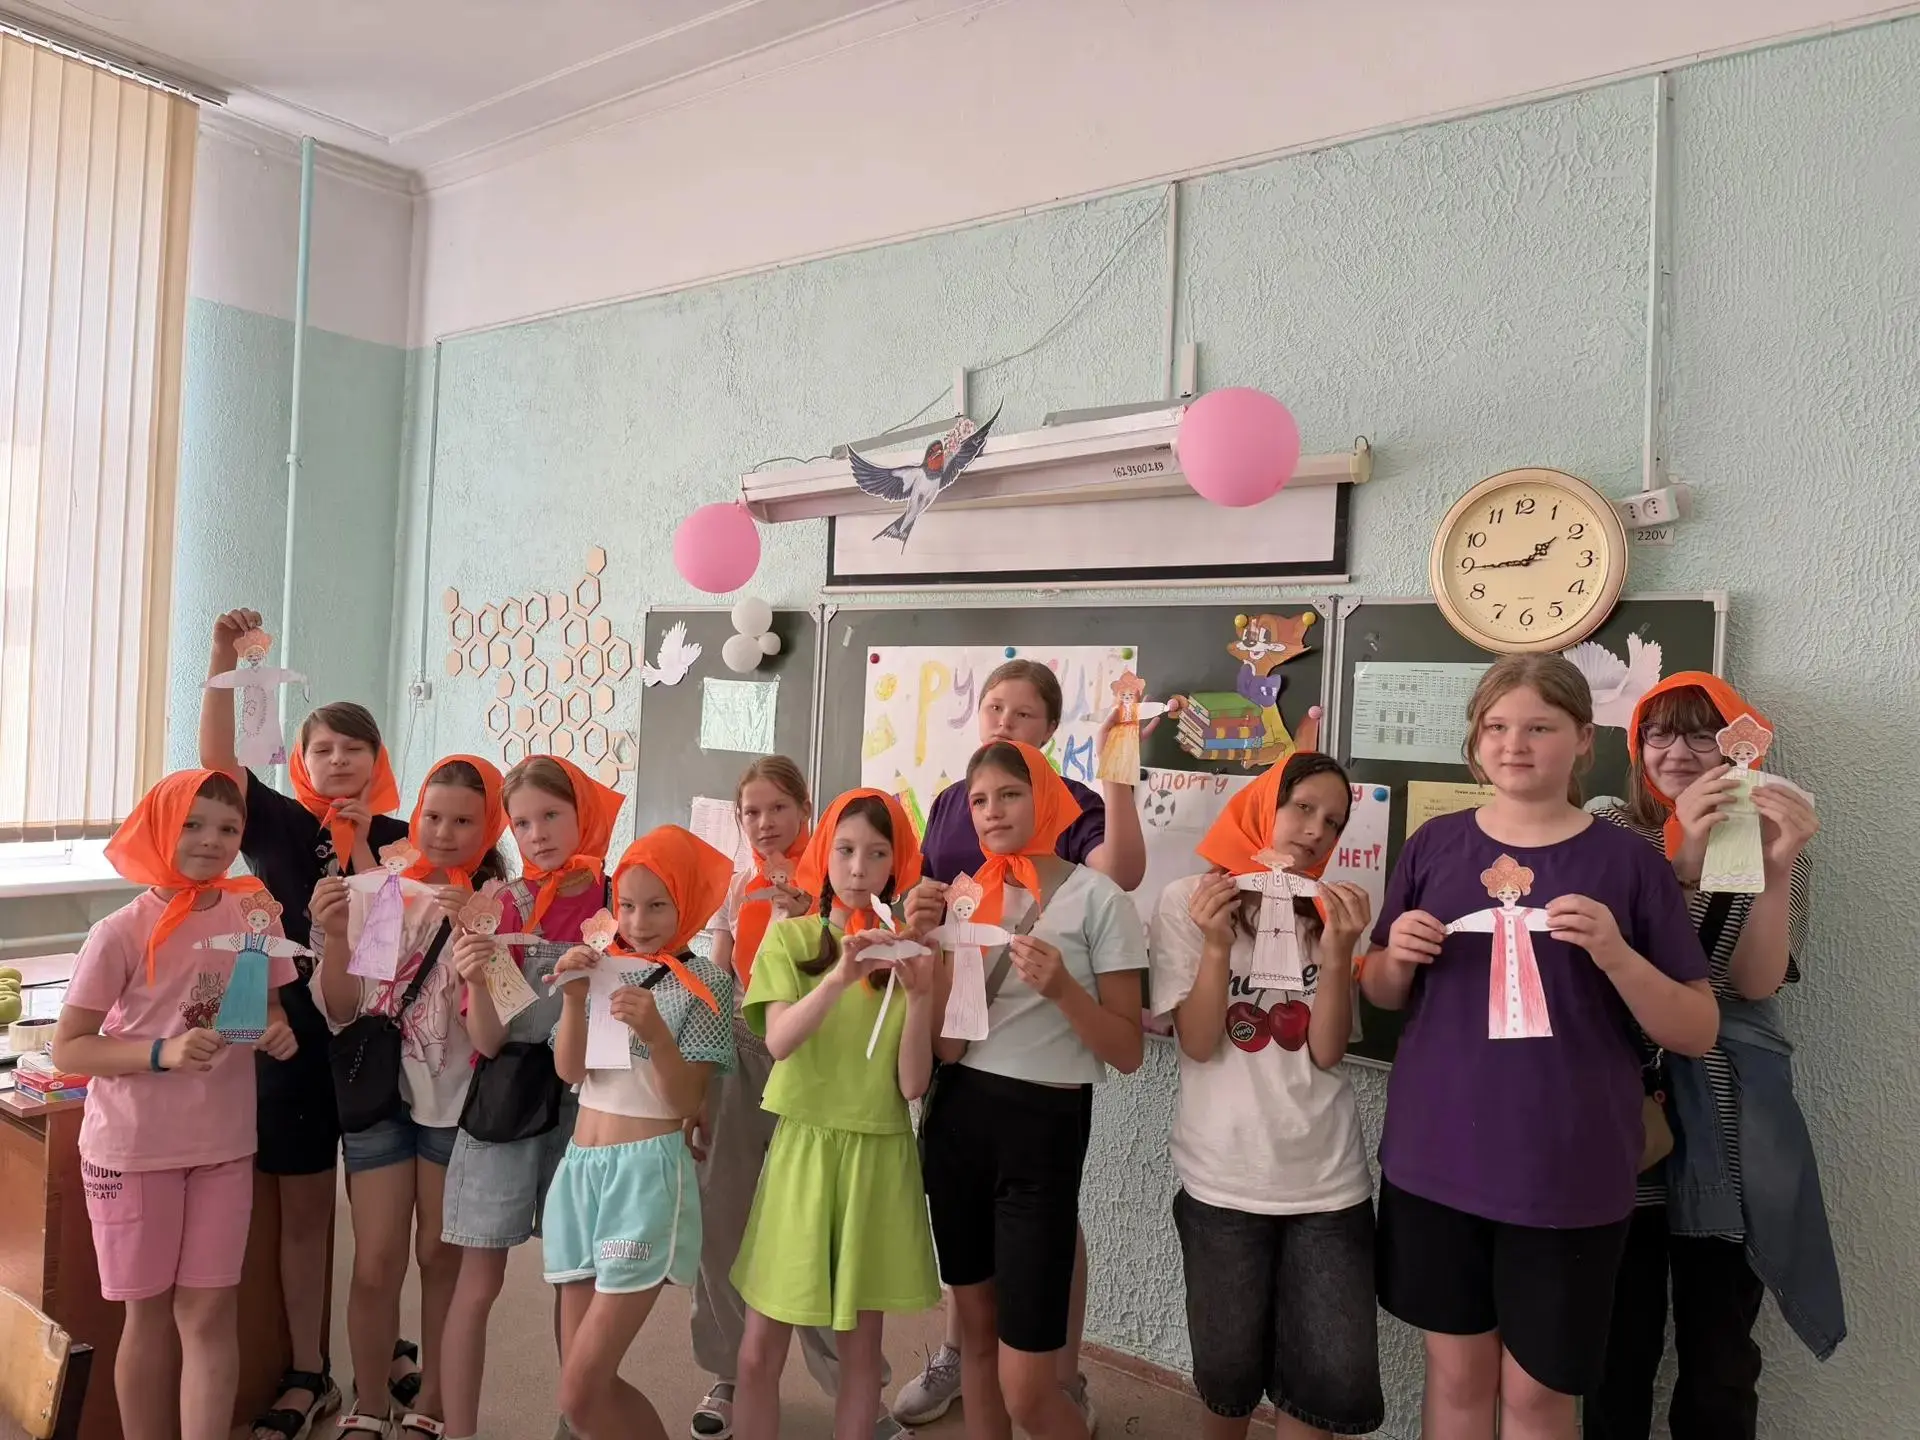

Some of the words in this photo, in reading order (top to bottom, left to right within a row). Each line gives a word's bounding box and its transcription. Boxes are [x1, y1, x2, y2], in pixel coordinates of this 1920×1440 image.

[1515, 498, 1536, 515] 12
[1551, 504, 1559, 520] 1
[1488, 508, 1504, 524] 11
[1467, 531, 1487, 548] 10
[1567, 523, 1584, 540] 2
[1637, 530, 1668, 541] 220V
[1461, 557, 1476, 575] 9
[1576, 550, 1593, 568] 3
[1469, 583, 1486, 600] 8
[1568, 579, 1585, 596] 4
[1492, 603, 1507, 620] 7
[1519, 608, 1534, 626] 6
[1547, 601, 1563, 618] 5
[1338, 844, 1382, 871] НЕТ!
[600, 1239, 652, 1261] BROOKLYN
